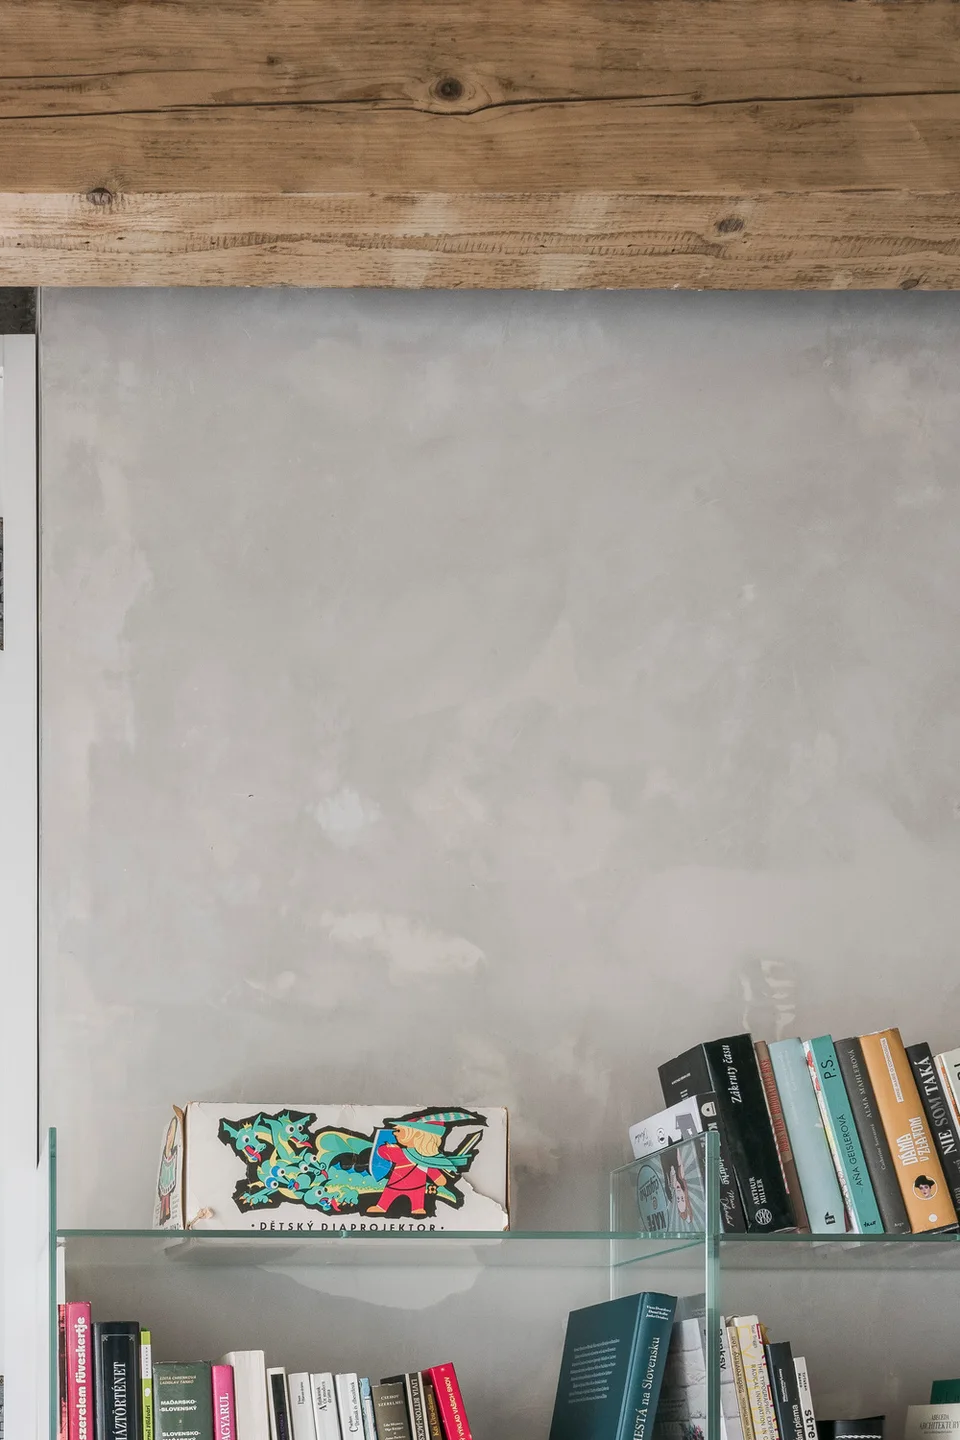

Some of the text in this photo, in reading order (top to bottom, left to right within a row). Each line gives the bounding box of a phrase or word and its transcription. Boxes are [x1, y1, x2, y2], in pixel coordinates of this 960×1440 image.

[722, 1044, 742, 1103] Zákruty času
[824, 1054, 838, 1080] P.S.
[912, 1055, 940, 1096] TAKÁ
[927, 1095, 949, 1127] SOM
[840, 1113, 857, 1168] GEISLEROVÁ
[908, 1115, 931, 1156] ZLATOM
[937, 1129, 957, 1155] NIE
[894, 1132, 918, 1166] DÁMA
[748, 1176, 760, 1207] ARTHUR
[757, 1179, 767, 1205] MILLER
[259, 1221, 314, 1231] DĚTSKÝ
[74, 1316, 86, 1384] füveskertje
[641, 1336, 660, 1391] Slovensku
[411, 1378, 419, 1397] LIVIA
[443, 1375, 453, 1392] SNOV
[447, 1392, 459, 1414] VAŠICH
[641, 1392, 651, 1406] na
[453, 1413, 465, 1436] VÝKLAD
[791, 1404, 803, 1428] písma
